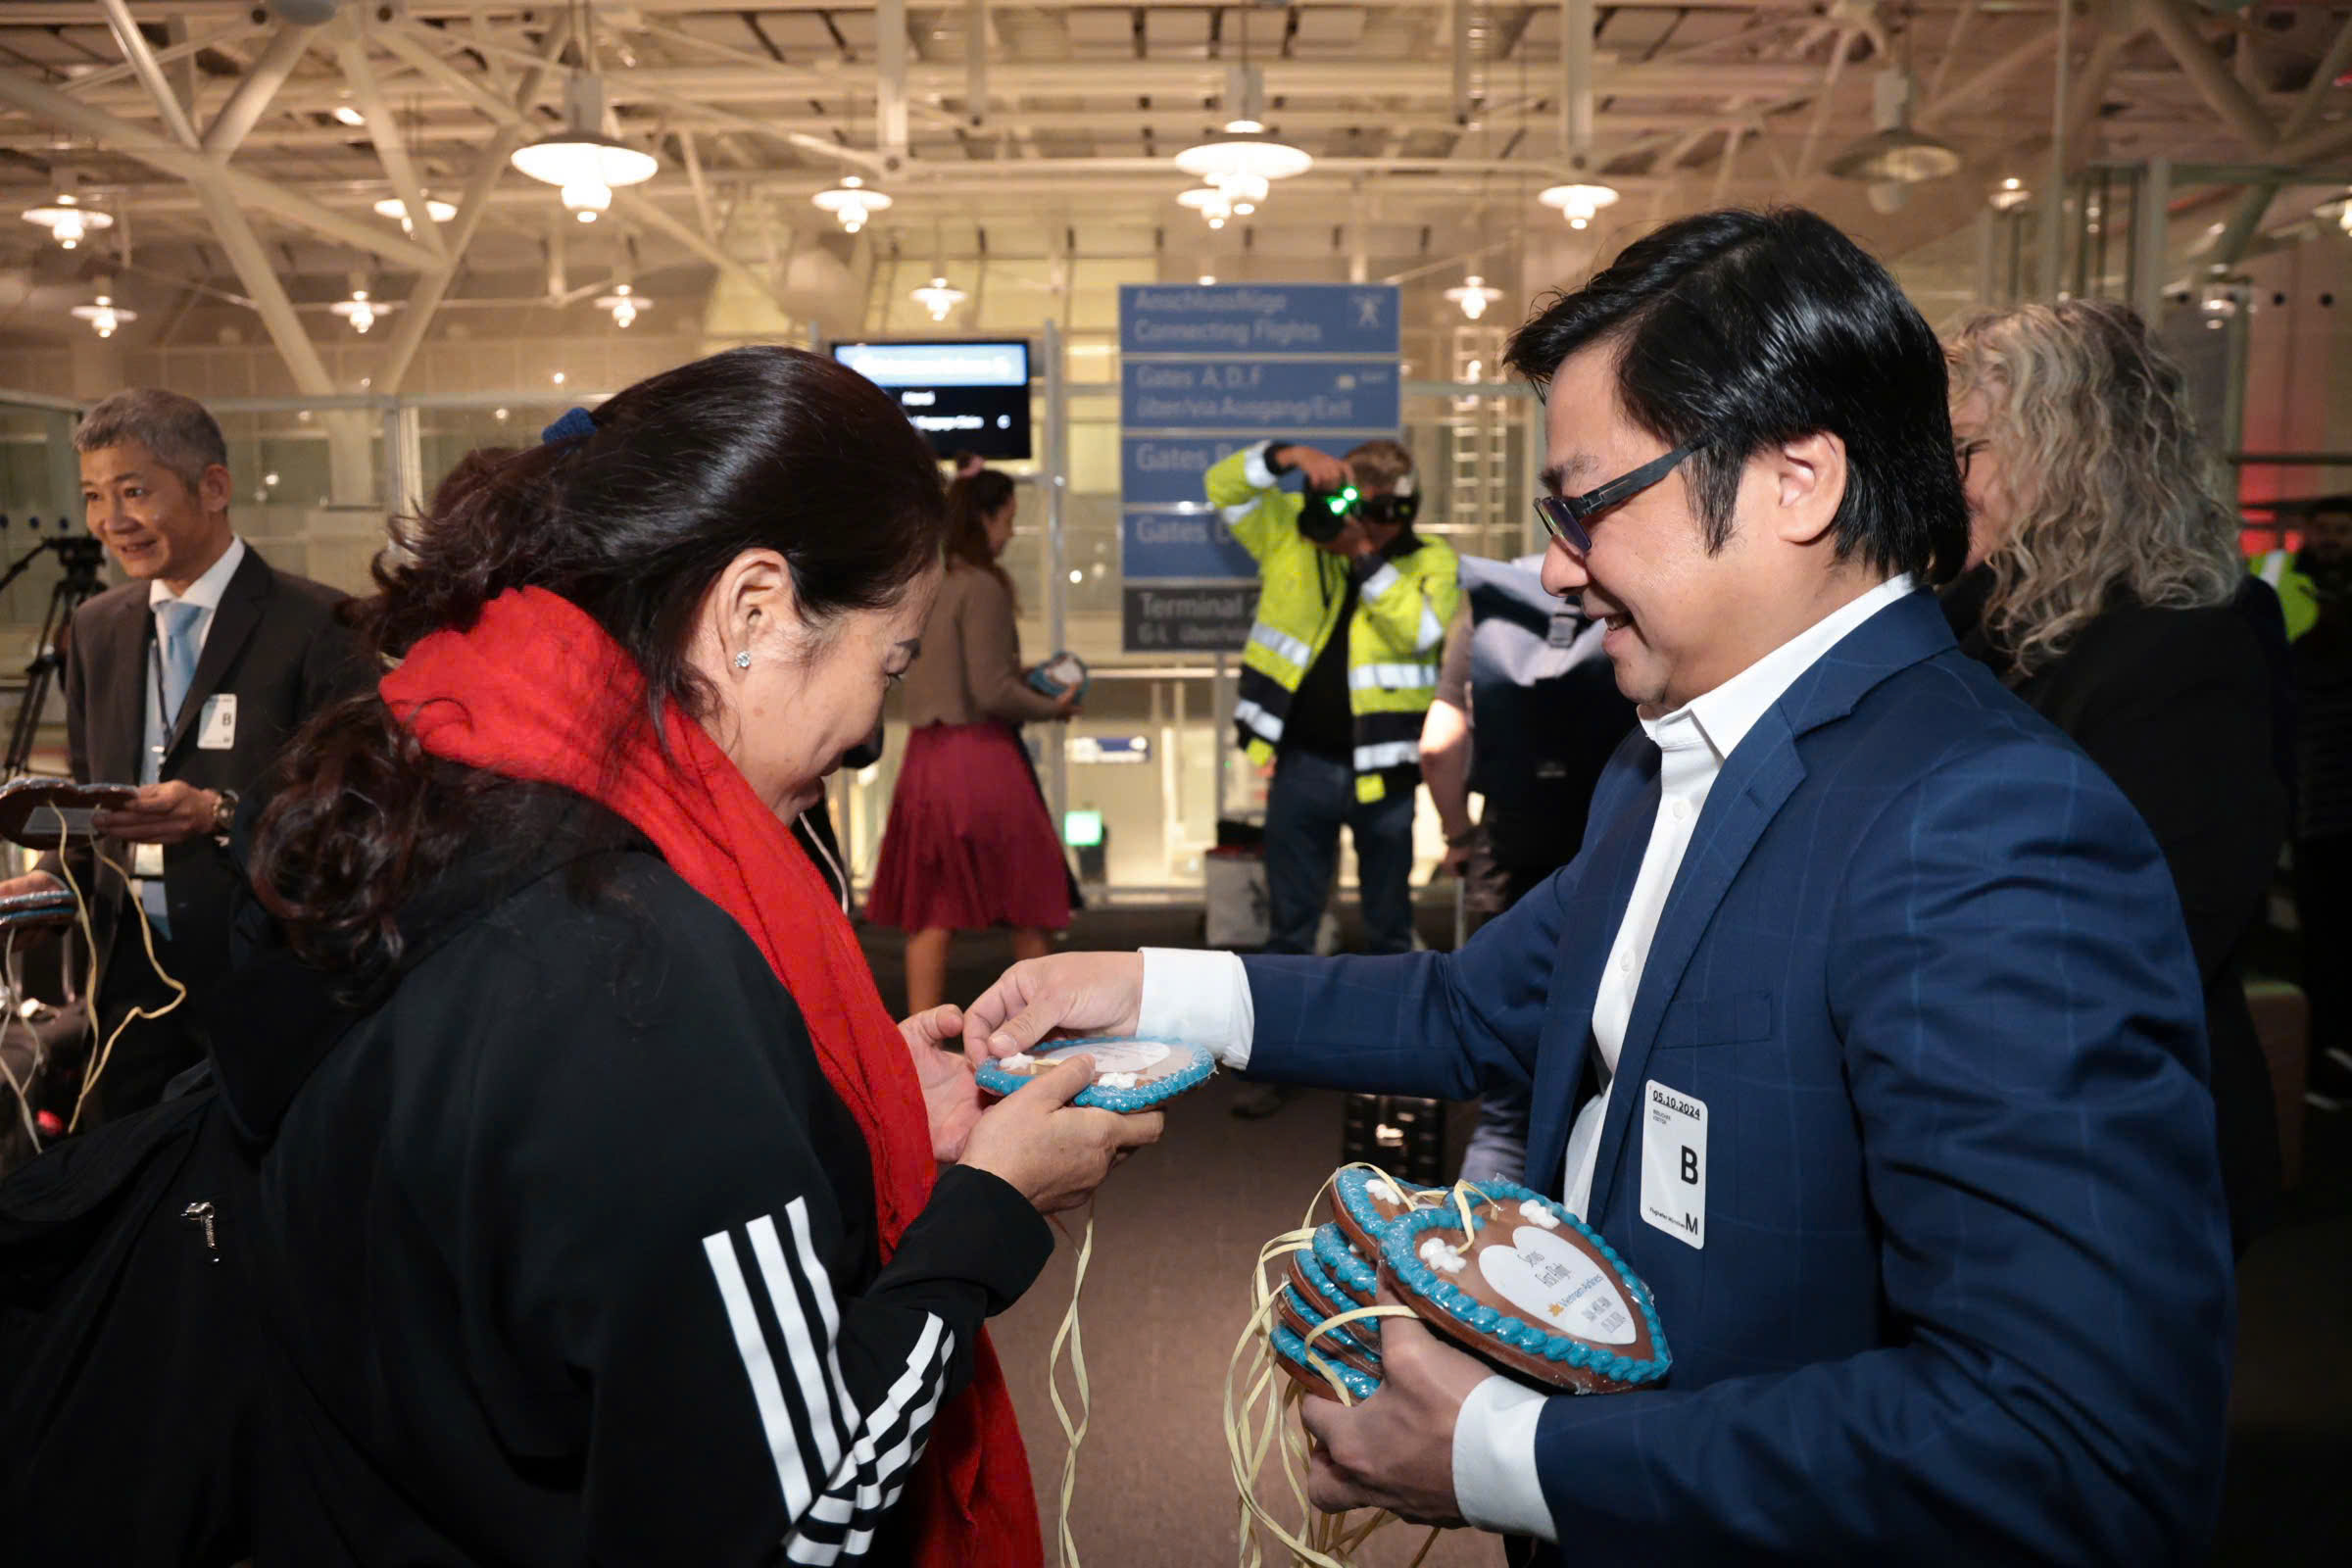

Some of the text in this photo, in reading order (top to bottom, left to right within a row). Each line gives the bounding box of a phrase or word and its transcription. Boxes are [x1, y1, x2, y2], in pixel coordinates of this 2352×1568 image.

[1134, 319, 1321, 345] Connecting Flights
[1137, 366, 1193, 388] Gates
[1137, 443, 1206, 471] Gates
[1137, 518, 1206, 543] Gates
[1139, 592, 1244, 617] Terminal
[1653, 1090, 1700, 1119] 05.10.2024
[1681, 1145, 1698, 1186] B
[1685, 1212, 1698, 1236] M
